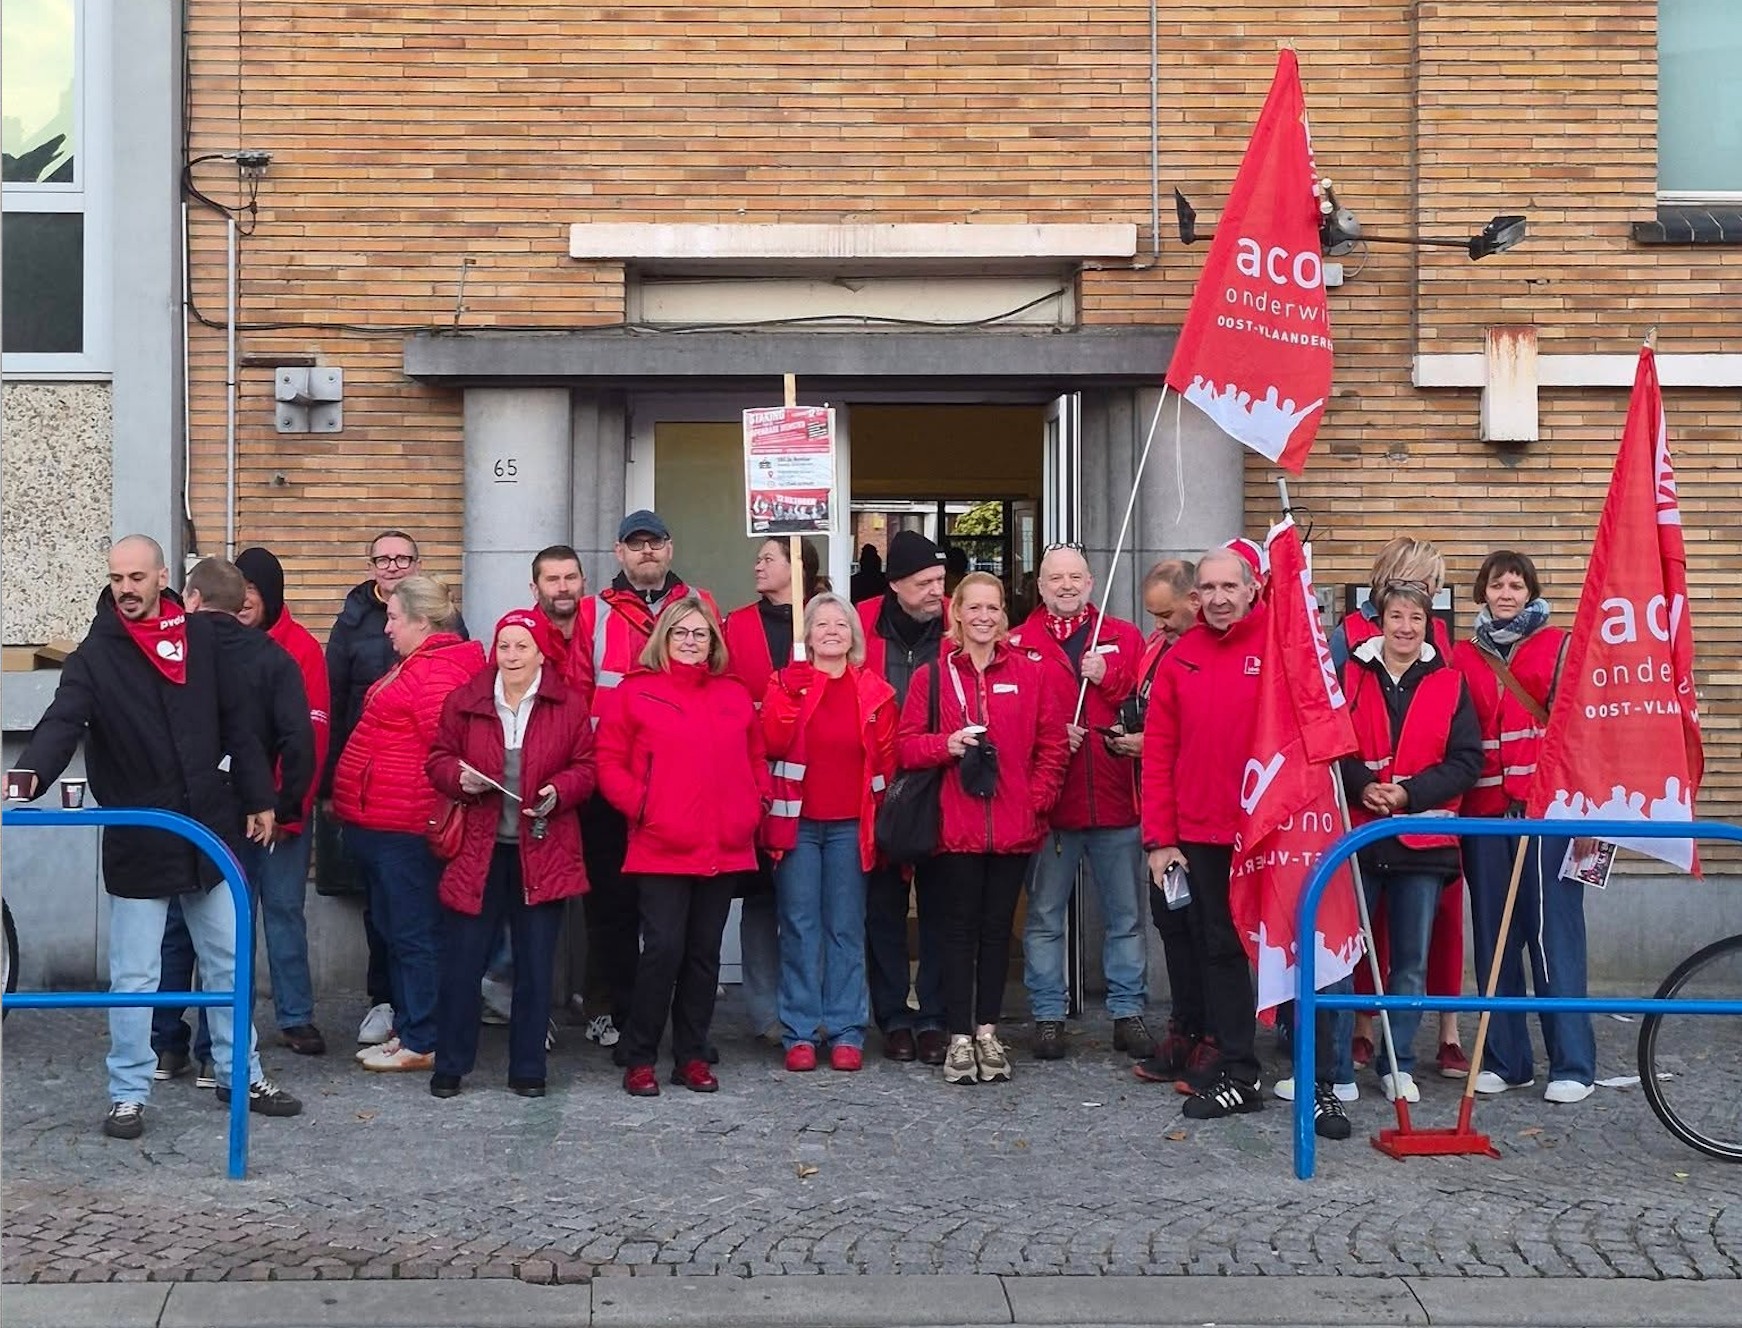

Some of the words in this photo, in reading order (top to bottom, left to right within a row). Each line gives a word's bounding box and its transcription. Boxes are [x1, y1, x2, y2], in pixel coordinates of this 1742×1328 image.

[1236, 237, 1324, 289] aco
[1217, 315, 1334, 351] OOST-VLAANDERE
[494, 459, 517, 477] 65
[1600, 594, 1670, 645] ac
[1592, 656, 1672, 687] onde
[1585, 700, 1681, 719] OOST-VLAA
